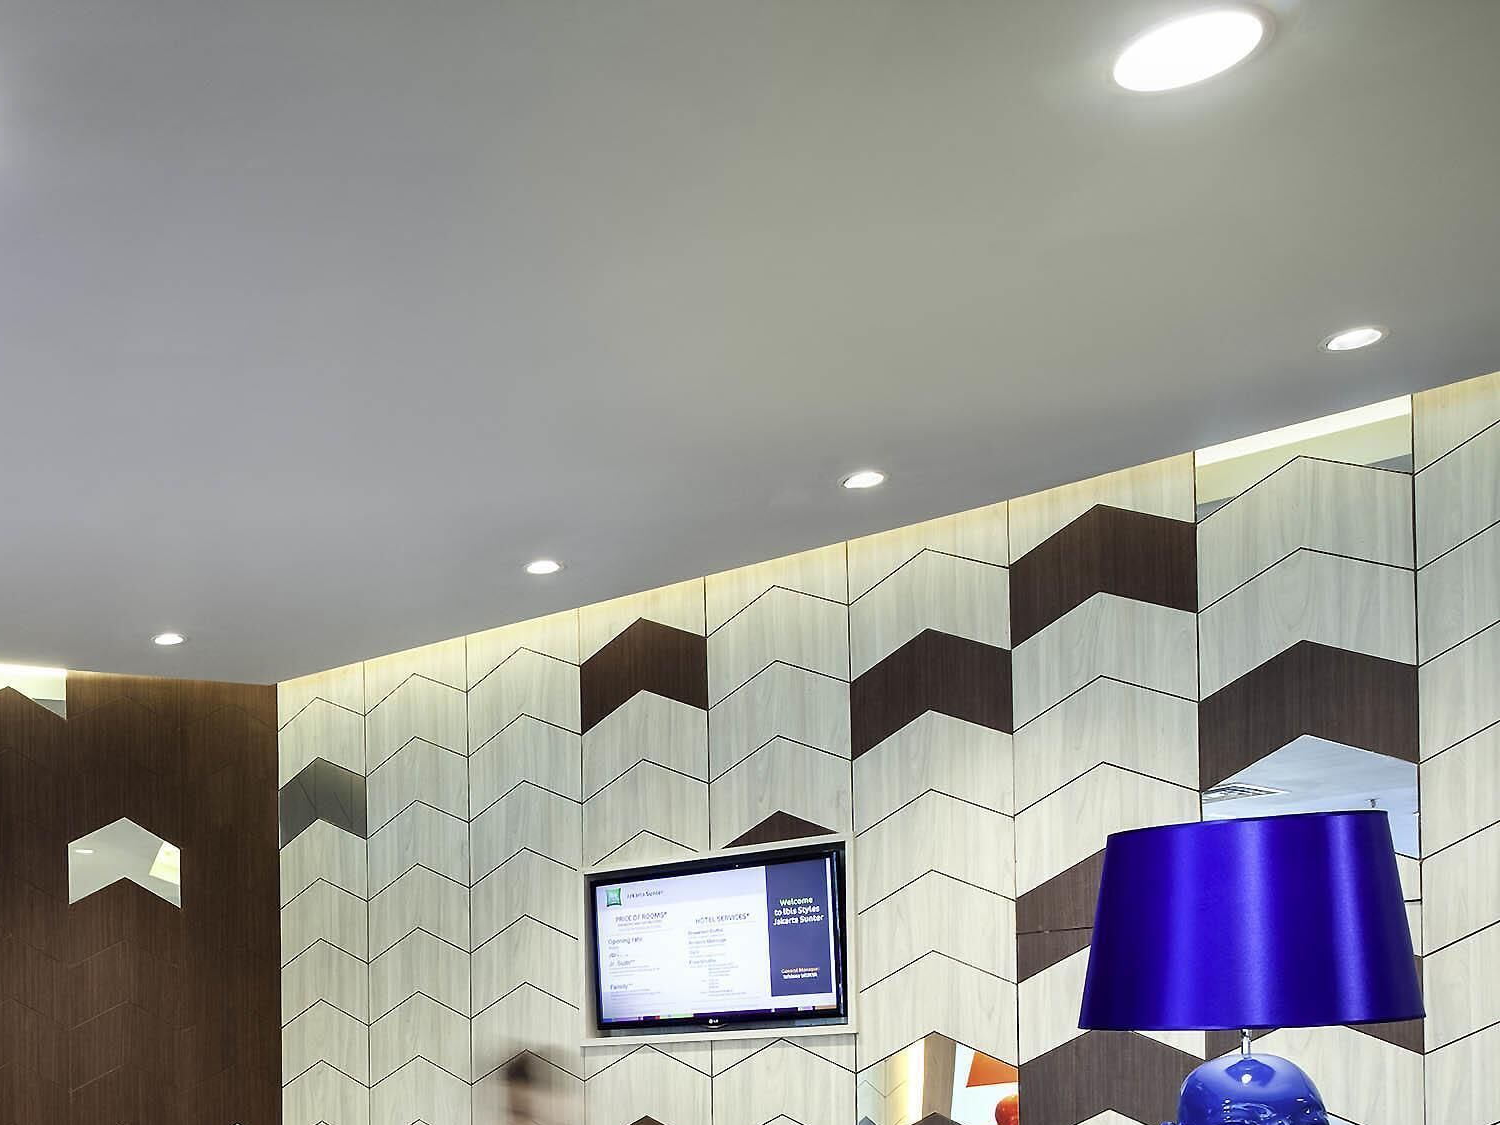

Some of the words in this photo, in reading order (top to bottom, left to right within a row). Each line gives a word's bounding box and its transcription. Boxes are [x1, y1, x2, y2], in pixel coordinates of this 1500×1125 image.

[779, 897, 813, 906] Welcome
[774, 909, 782, 917] to
[797, 905, 820, 915] Styles
[615, 915, 632, 923] PRICE
[773, 917, 799, 926] Jakarta
[799, 914, 825, 924] Sunter
